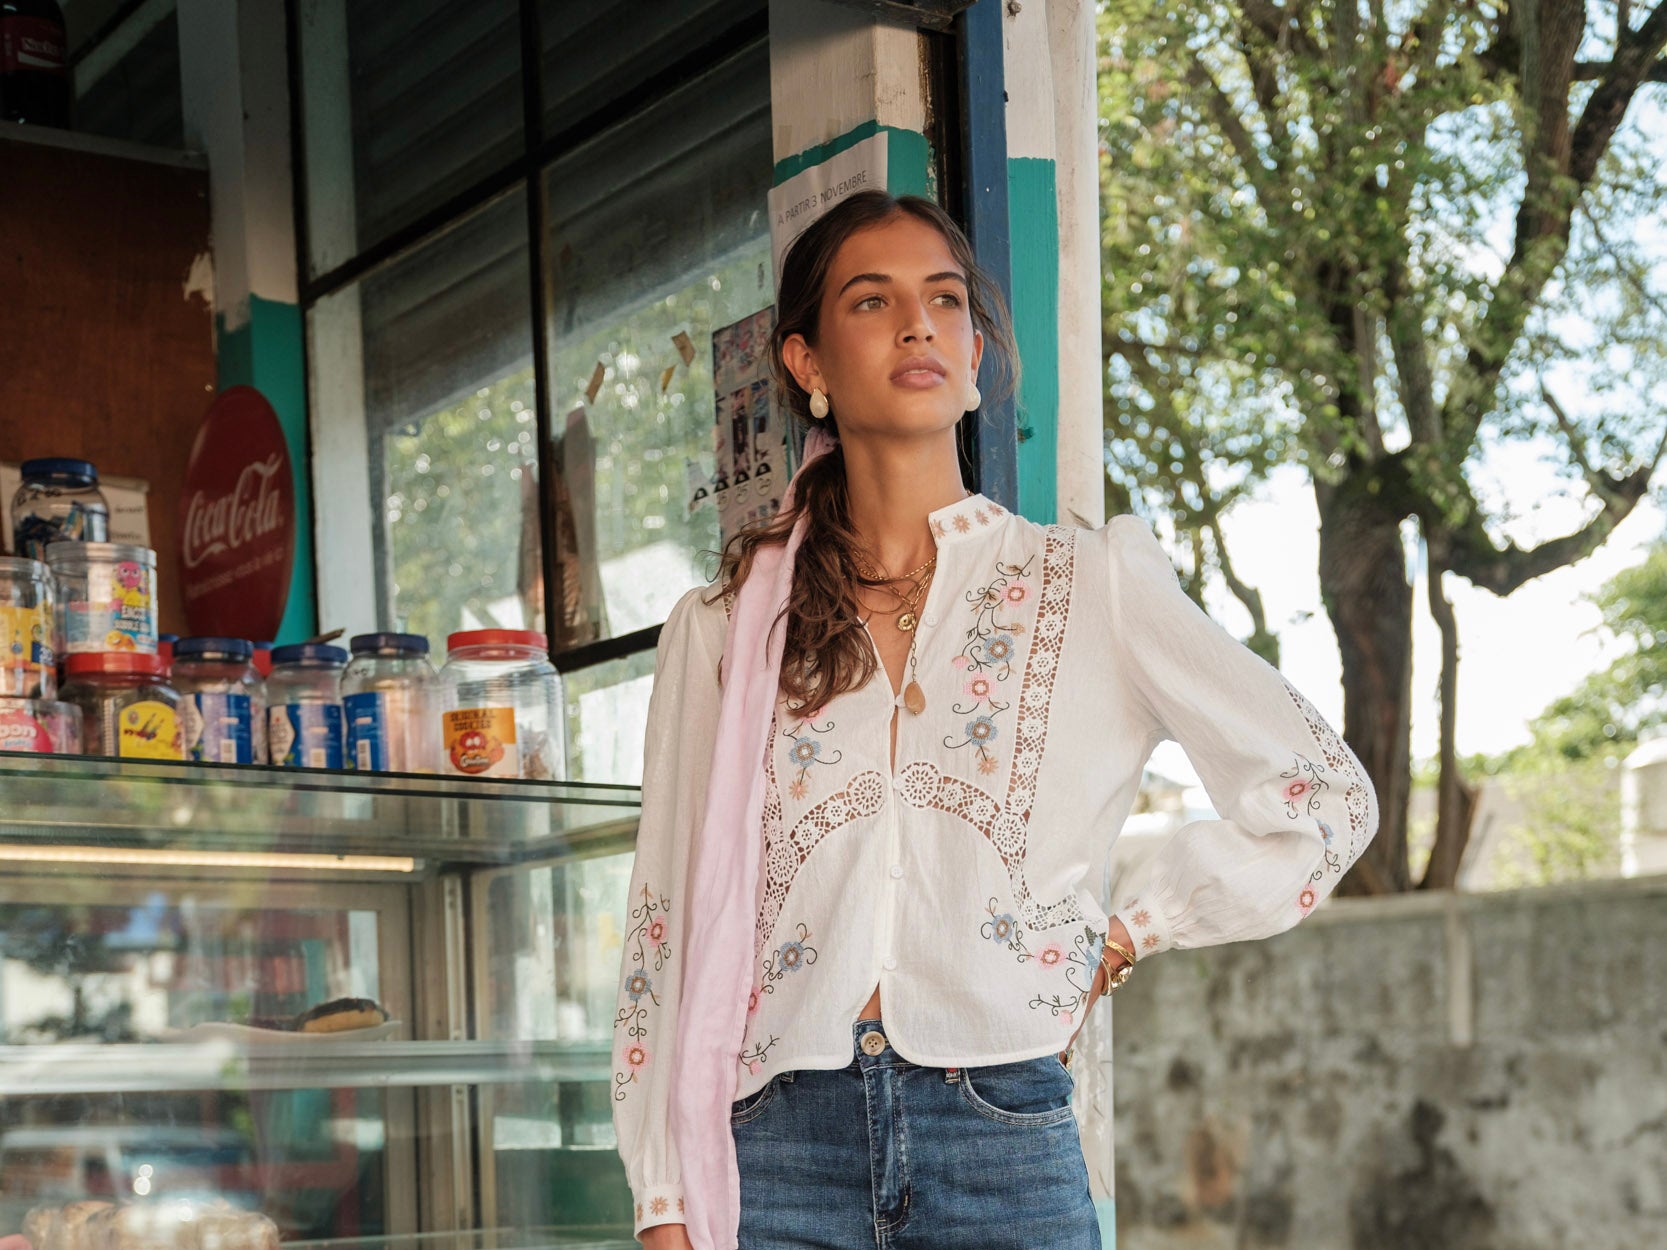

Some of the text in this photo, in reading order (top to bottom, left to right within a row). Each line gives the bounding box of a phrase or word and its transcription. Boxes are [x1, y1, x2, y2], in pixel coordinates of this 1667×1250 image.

[777, 170, 867, 226] A PARTIR 3 NOVEMBRE
[183, 453, 284, 569] Coca-Cola
